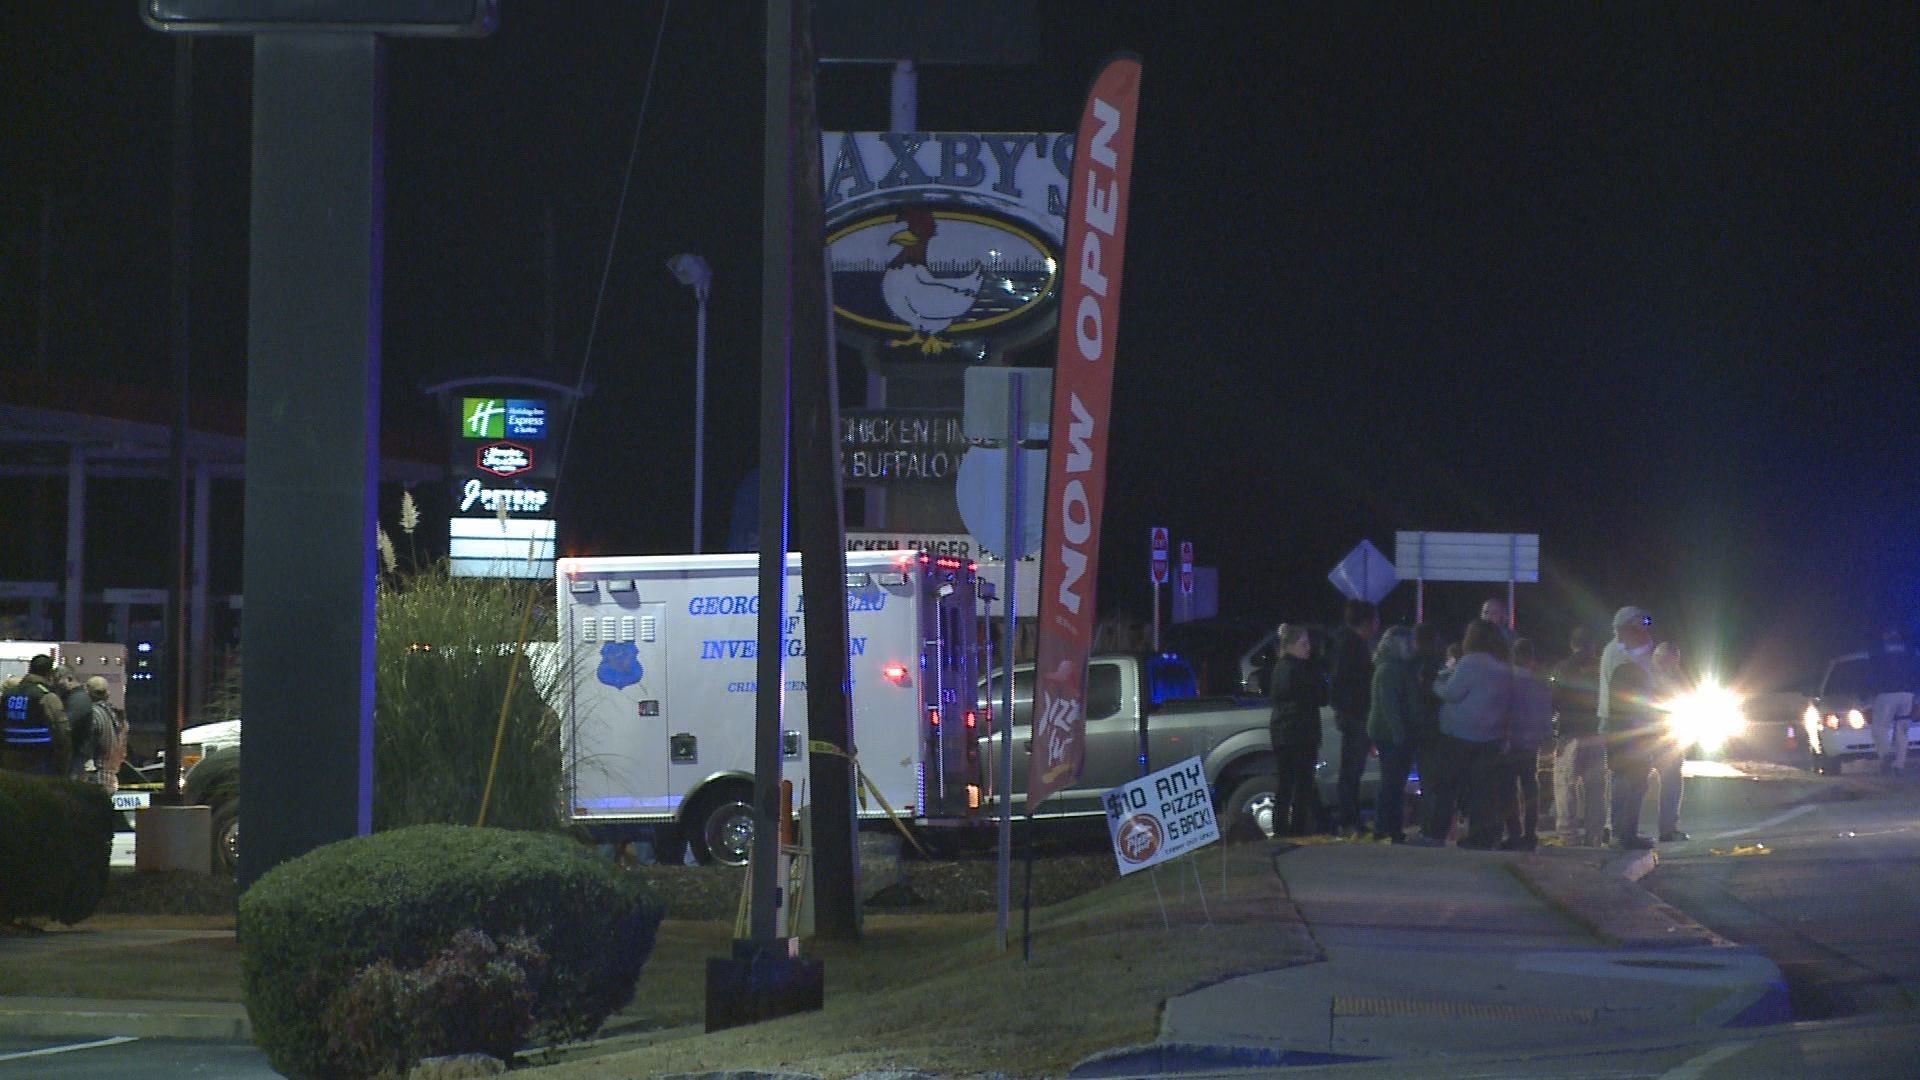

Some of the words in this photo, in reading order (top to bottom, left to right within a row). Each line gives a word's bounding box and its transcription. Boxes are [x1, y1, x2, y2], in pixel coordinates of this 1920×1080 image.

[1058, 391, 1094, 615] NOW
[1076, 97, 1121, 361] OPEN
[852, 451, 949, 478] BUFFALO
[1106, 786, 1148, 820] $10
[1155, 763, 1201, 801] ANY
[1160, 788, 1207, 819] PIZZA
[1179, 807, 1214, 835] BACK!
